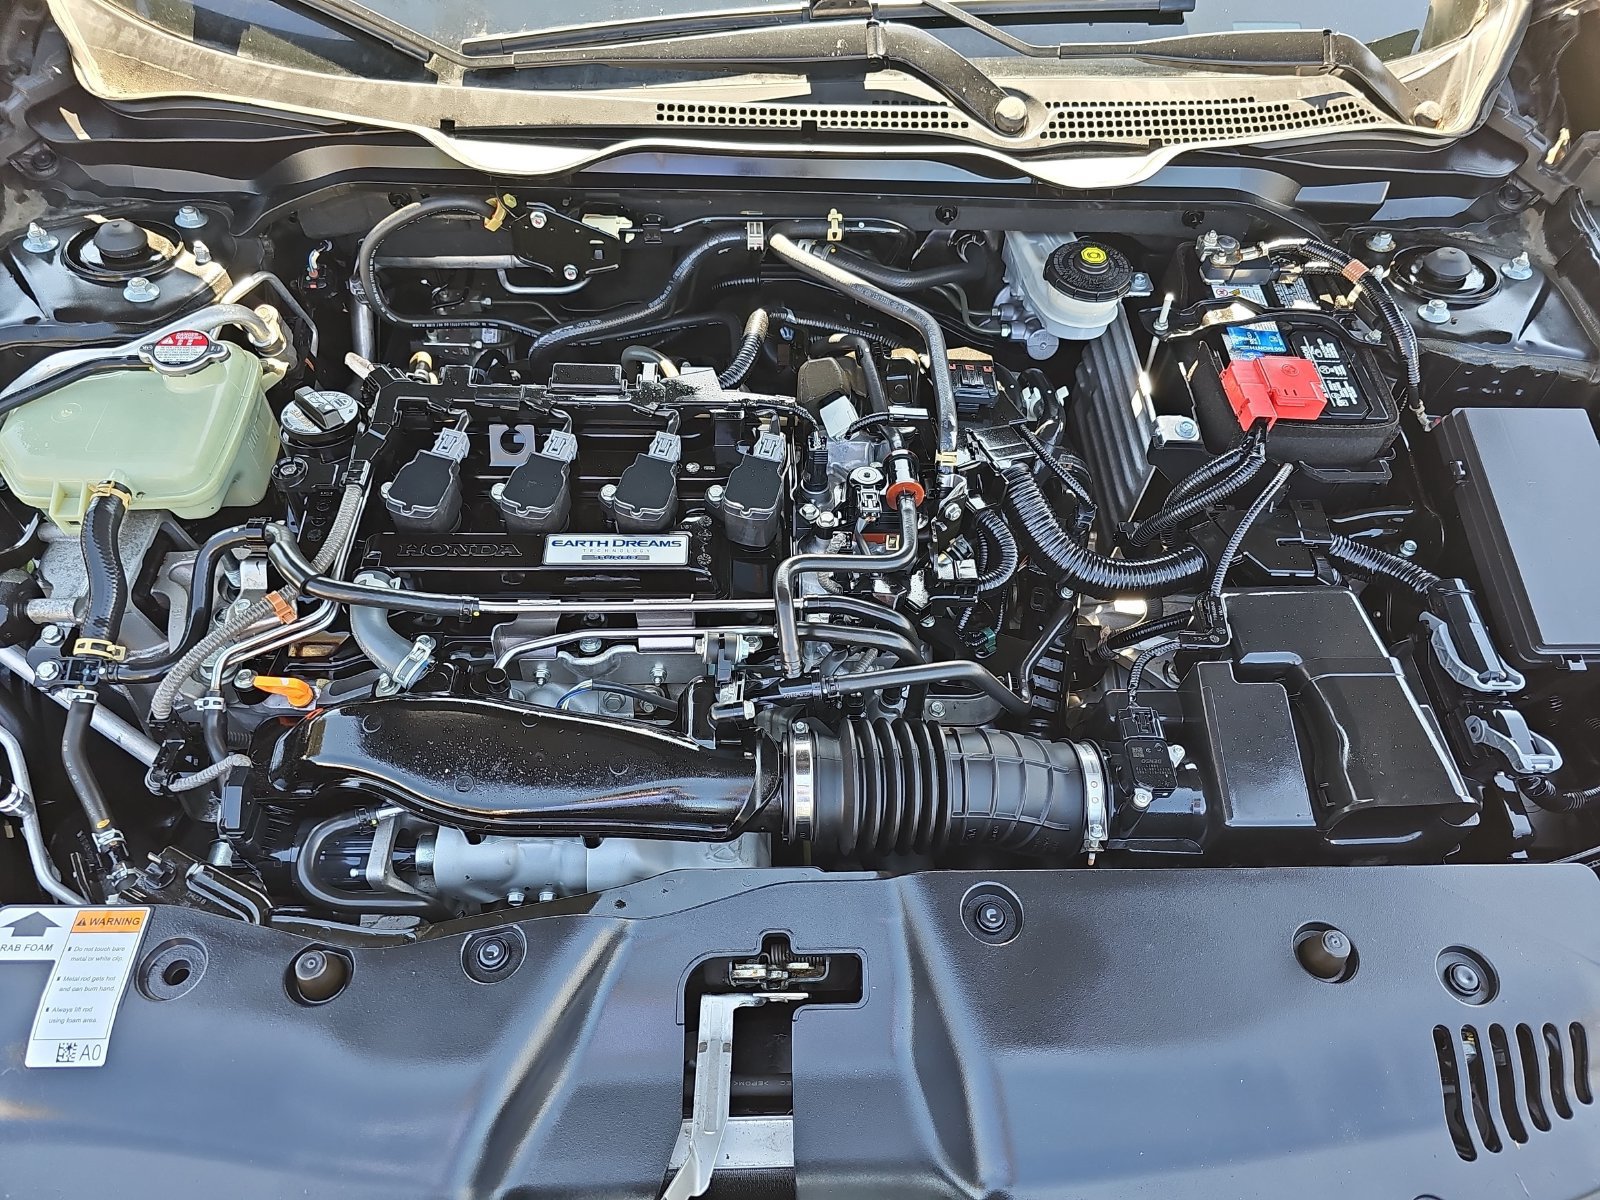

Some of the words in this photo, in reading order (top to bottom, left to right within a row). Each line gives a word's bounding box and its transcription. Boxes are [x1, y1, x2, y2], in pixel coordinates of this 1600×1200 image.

[612, 539, 682, 547] DREAMS
[397, 543, 523, 557] HONDA
[89, 917, 141, 926] WARNING
[0, 943, 21, 951] RAB
[23, 943, 54, 951] FOAM
[79, 1044, 102, 1061] A0
